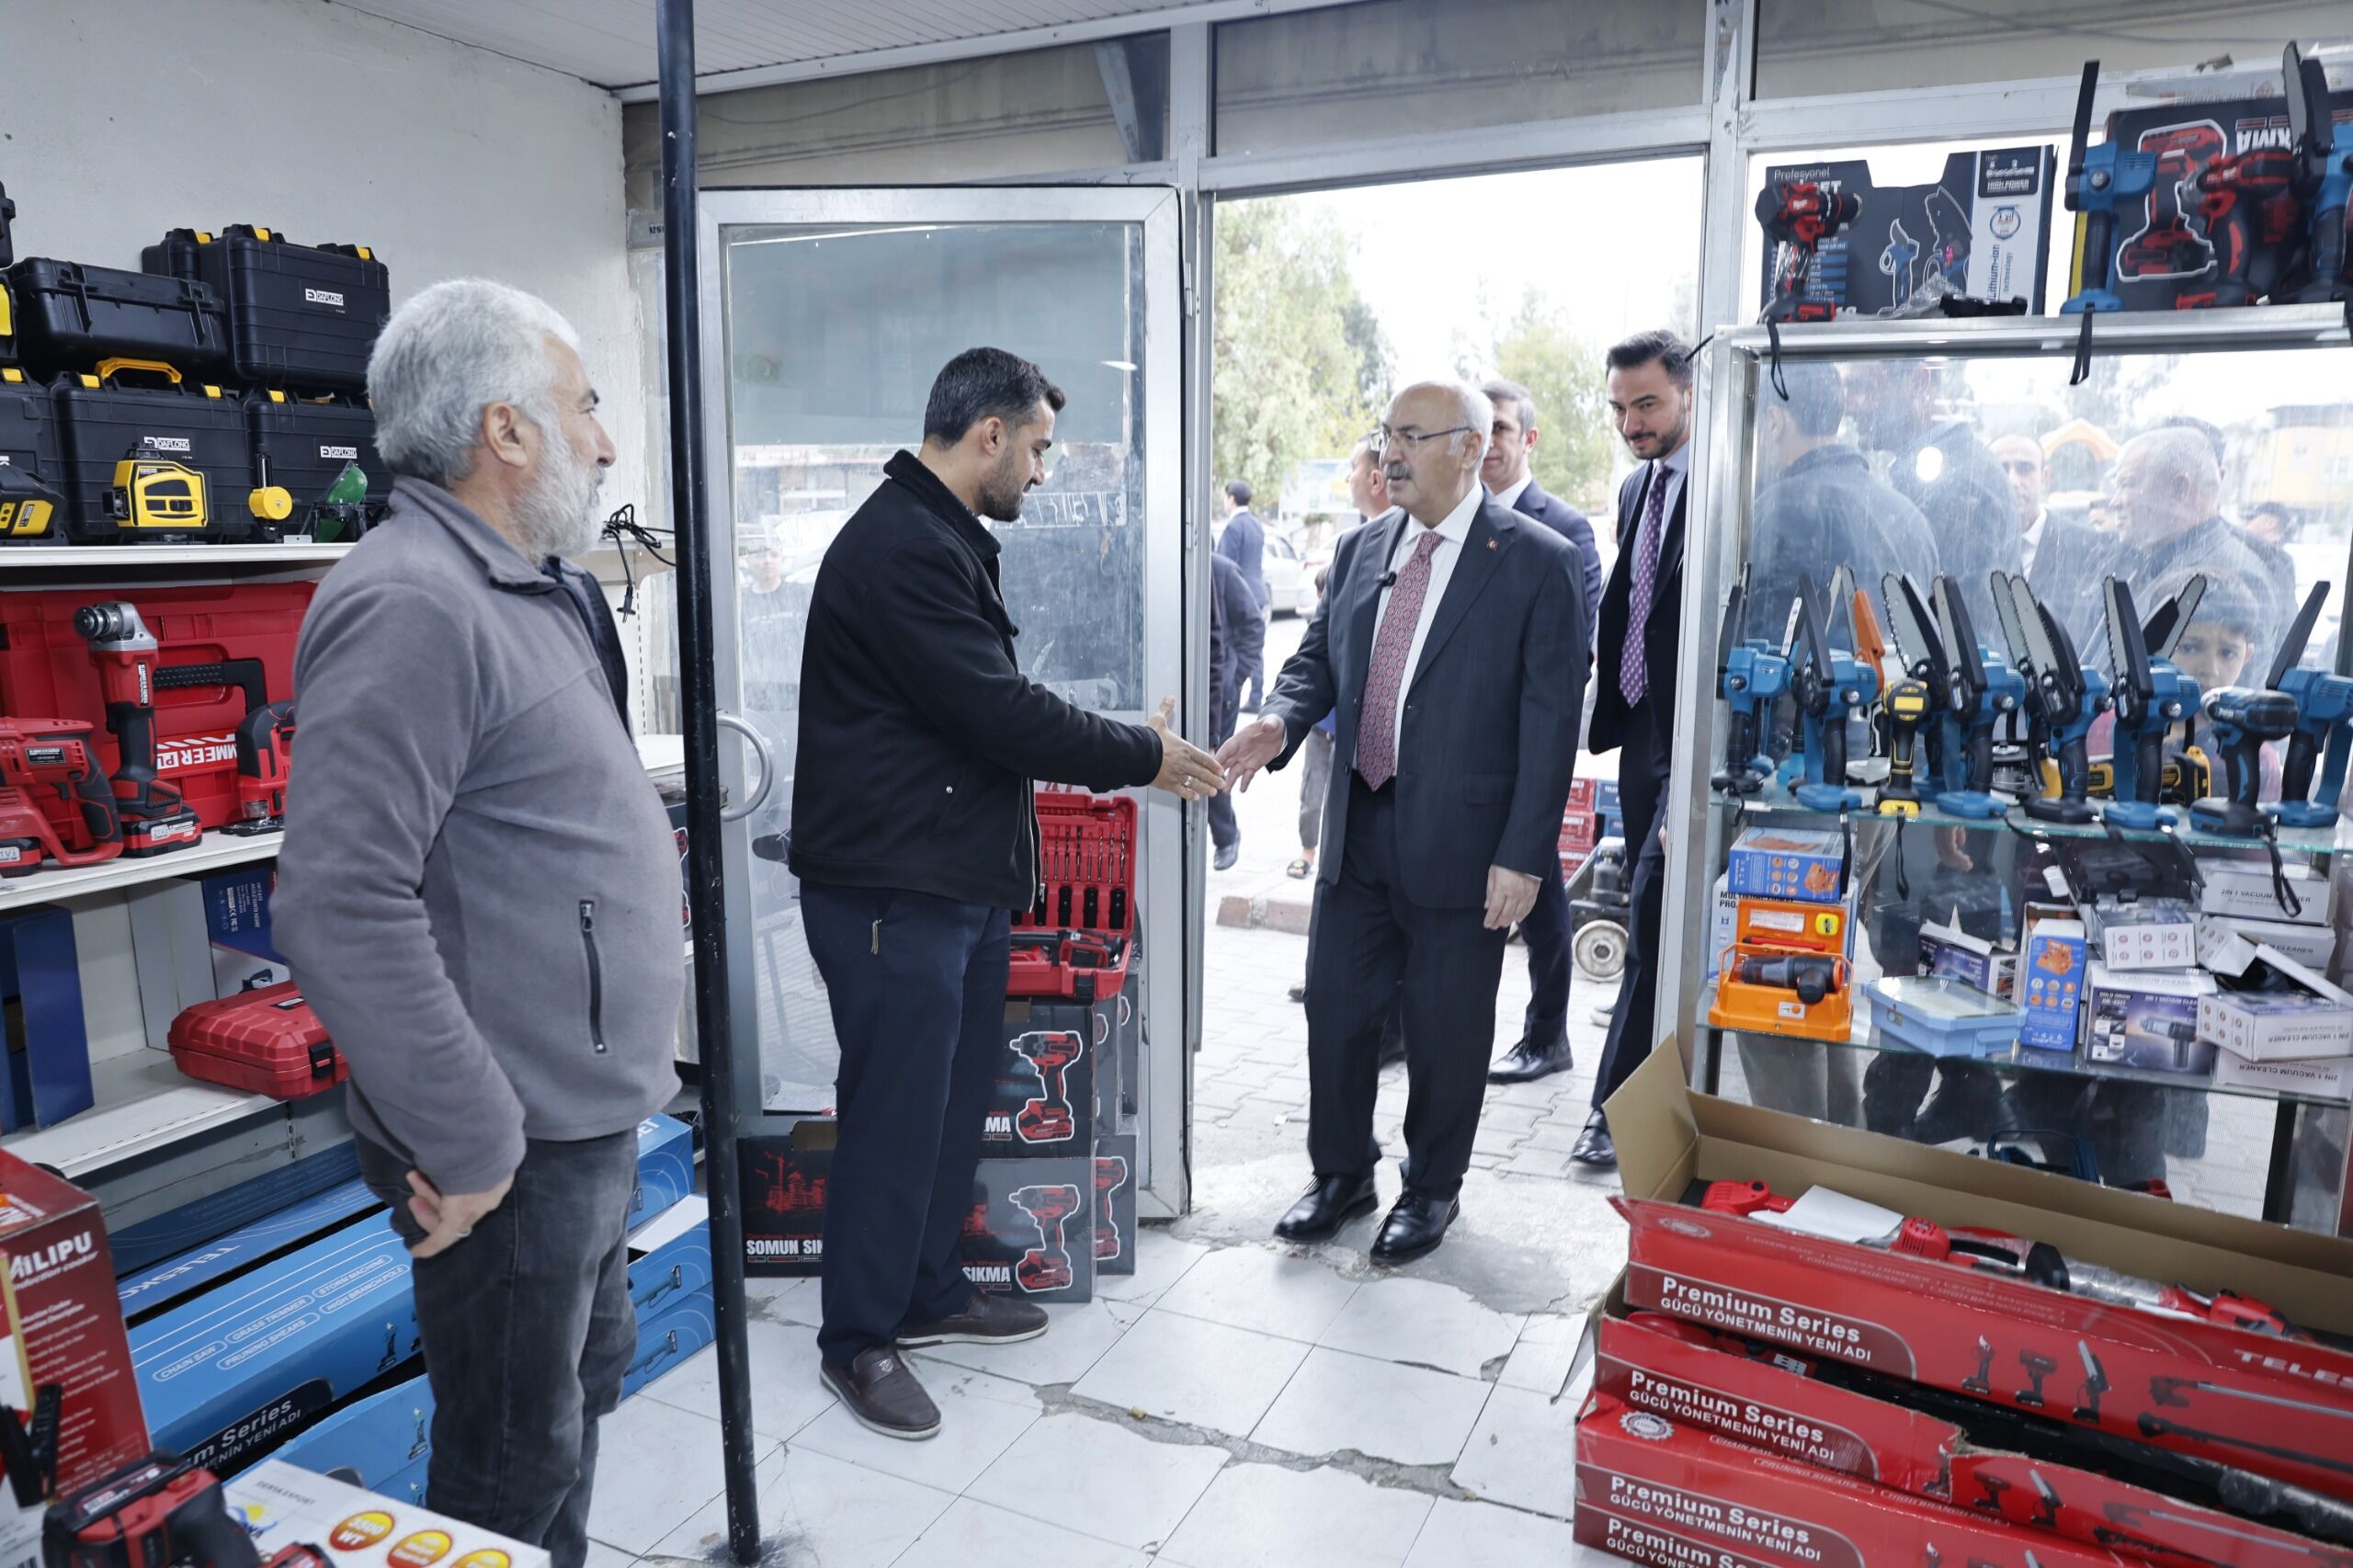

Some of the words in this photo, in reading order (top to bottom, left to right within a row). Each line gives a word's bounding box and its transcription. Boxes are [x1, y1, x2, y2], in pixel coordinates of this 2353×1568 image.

[1774, 165, 1830, 182] Profesyonel
[157, 439, 189, 449] DAFLONG
[2241, 890, 2272, 899] VACUUM
[2239, 1062, 2279, 1074] CLEANER
[2279, 1067, 2315, 1080] VACUUM
[746, 1239, 799, 1256] SOMUN
[326, 1292, 348, 1312] HIGH
[347, 1278, 381, 1301] BRANCH
[380, 1266, 405, 1285] POLE
[347, 1256, 388, 1282] MACHINE
[962, 1266, 1011, 1283] SIKMA
[232, 1316, 266, 1341] GRASS
[265, 1297, 308, 1325] TRIMMER
[1661, 1297, 1702, 1317] GÜCÜ
[1705, 1309, 1802, 1344] YÖNETMENİN
[1805, 1335, 1841, 1354] YENİ
[1843, 1344, 1871, 1361] ADI
[1663, 1276, 1773, 1321] Premium
[1779, 1307, 1860, 1344] Series
[161, 1356, 194, 1379] CHAIN
[192, 1345, 218, 1366] SAW
[223, 1339, 269, 1367] PRUNING
[267, 1318, 307, 1345] SHEARS
[222, 1399, 292, 1449] Series
[1630, 1389, 1669, 1411] GÜCÜ
[1672, 1402, 1768, 1440] YÖNETMENİN
[1770, 1432, 1805, 1452] YENİ
[1807, 1444, 1835, 1461] ADI
[1631, 1369, 1739, 1417] Premium
[1745, 1404, 1824, 1443] Series
[245, 1423, 278, 1449] YENİ
[278, 1408, 301, 1429] ADI
[1610, 1494, 1652, 1514] GÜCÜ
[1654, 1505, 1753, 1541] YÖNETMENİN
[1756, 1532, 1791, 1553] YENİ
[1793, 1544, 1822, 1562] ADI
[1611, 1474, 1722, 1520] Premium
[1728, 1507, 1810, 1543] Series
[337, 1529, 366, 1546] WT
[1607, 1536, 1646, 1558] GÜCÜ
[1608, 1517, 1712, 1566] Premium
